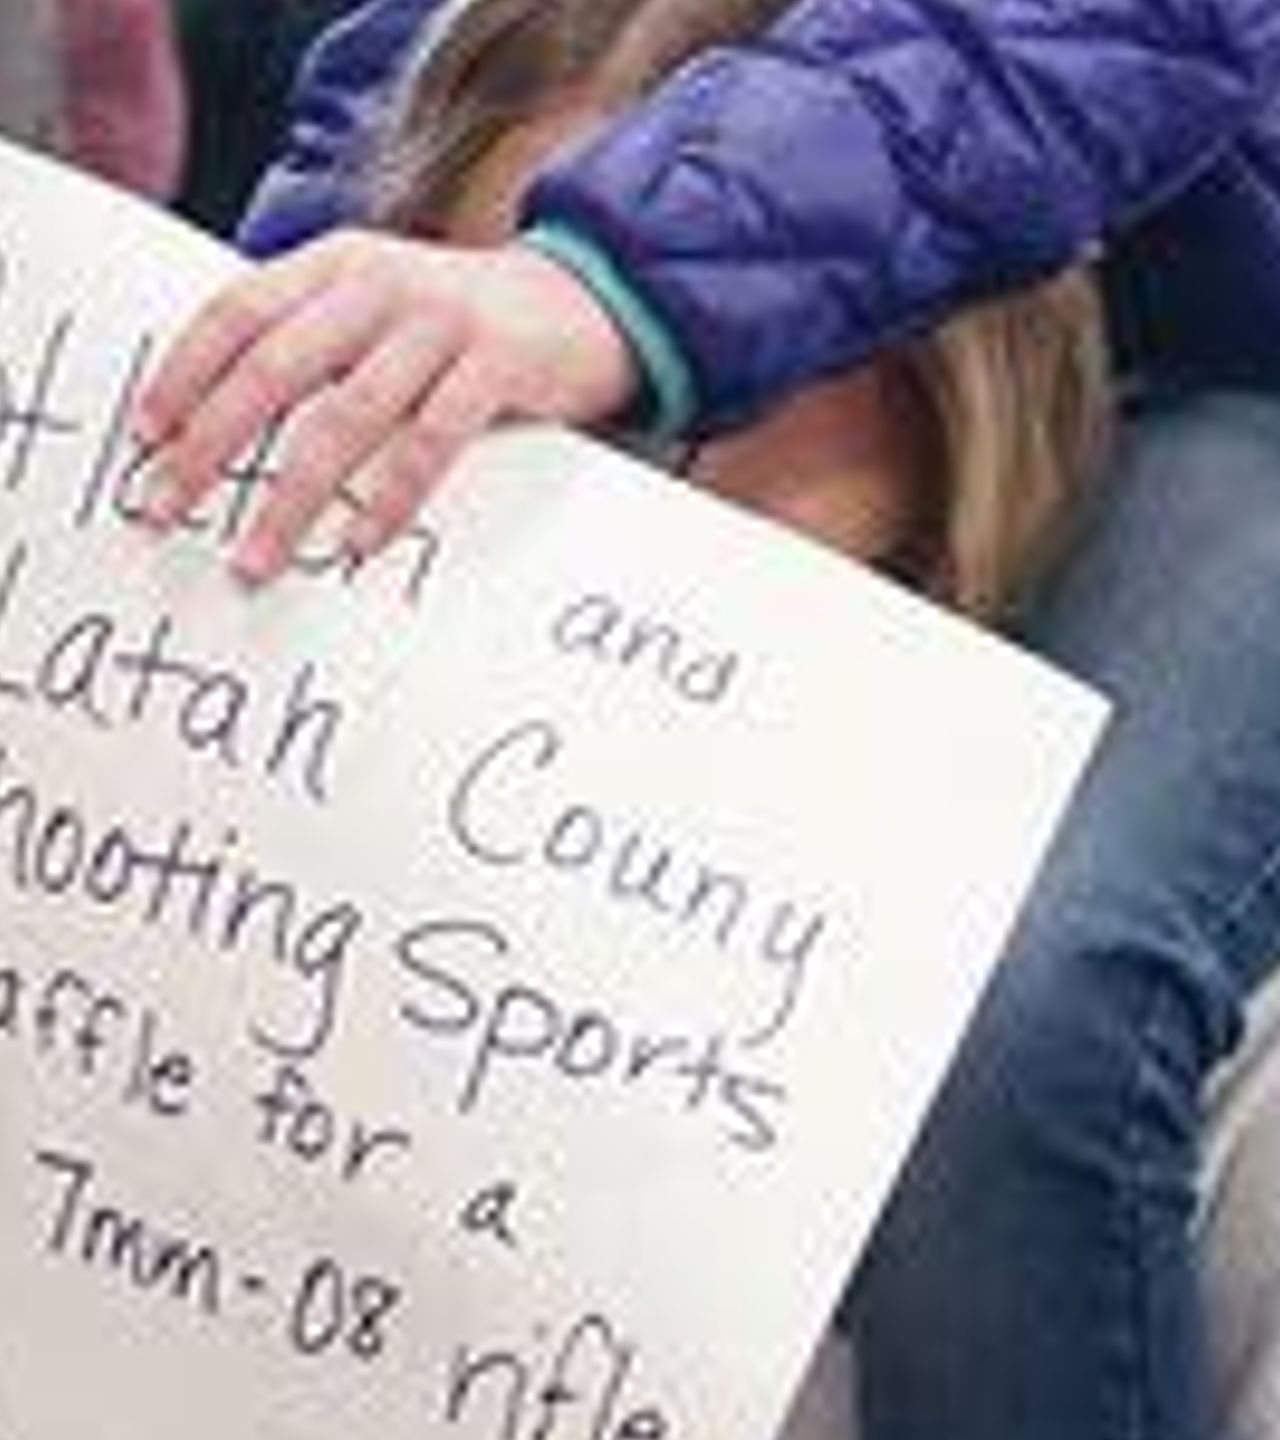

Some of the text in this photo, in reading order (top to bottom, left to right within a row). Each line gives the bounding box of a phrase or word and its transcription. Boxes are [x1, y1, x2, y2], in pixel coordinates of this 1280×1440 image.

[552, 587, 742, 705] and
[396, 918, 790, 1154] Sports
[254, 1064, 412, 1182] for
[460, 1180, 520, 1244] a
[34, 1148, 402, 1360] 7mm-08
